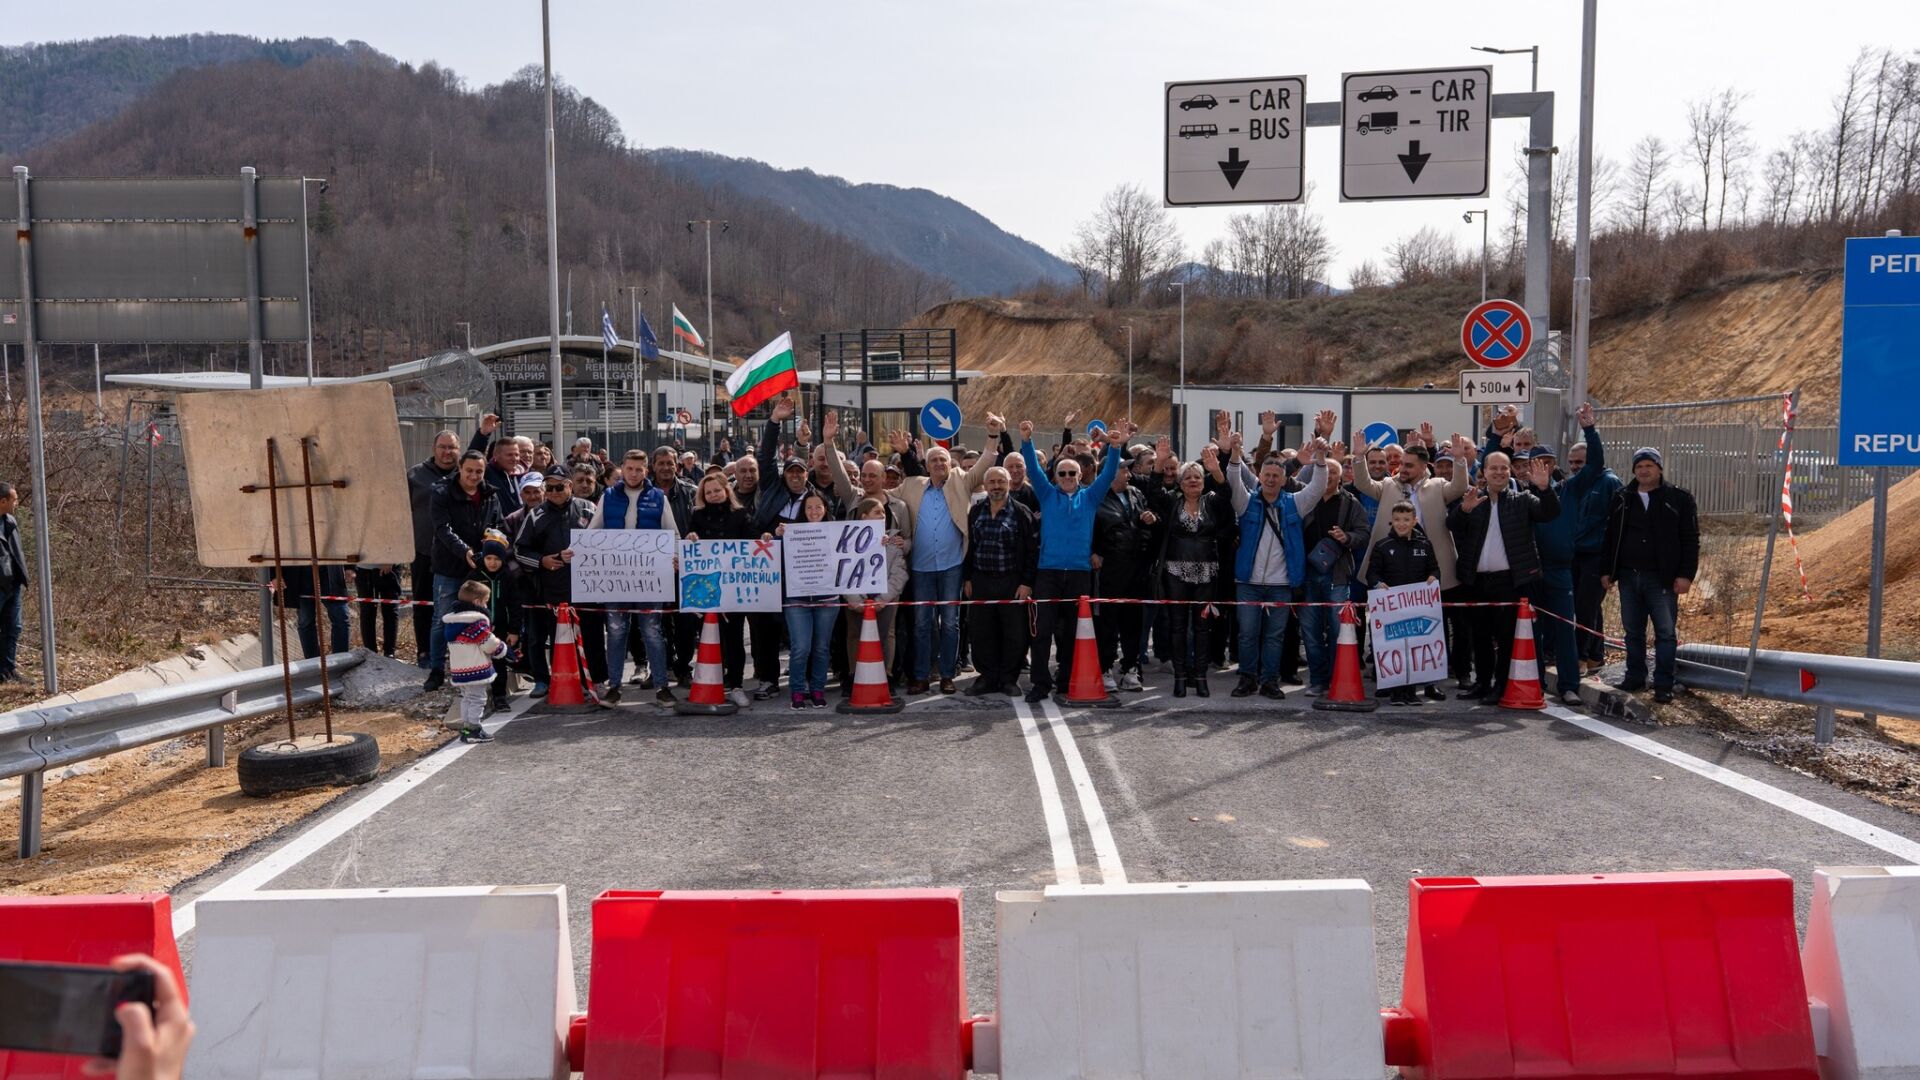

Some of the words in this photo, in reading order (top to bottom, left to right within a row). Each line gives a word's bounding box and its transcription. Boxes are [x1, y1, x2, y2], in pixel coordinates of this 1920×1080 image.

[1250, 88, 1290, 110] CAR
[1430, 79, 1475, 102] CAR
[1250, 117, 1290, 140] BUS
[1436, 109, 1469, 132] TIR
[487, 363, 546, 371] РЕПУБЛИКА
[490, 372, 545, 380] БЪЛГАРИЯ
[1854, 434, 1920, 453] REPU
[683, 543, 702, 559] НЕ
[711, 541, 749, 556] СМЕ
[685, 558, 721, 573] ВТОРА
[732, 556, 770, 570] РЪКА
[722, 569, 780, 585] ЕВРОПЕЙЦИ
[1376, 586, 1441, 613] ЧЕПИНЦИ
